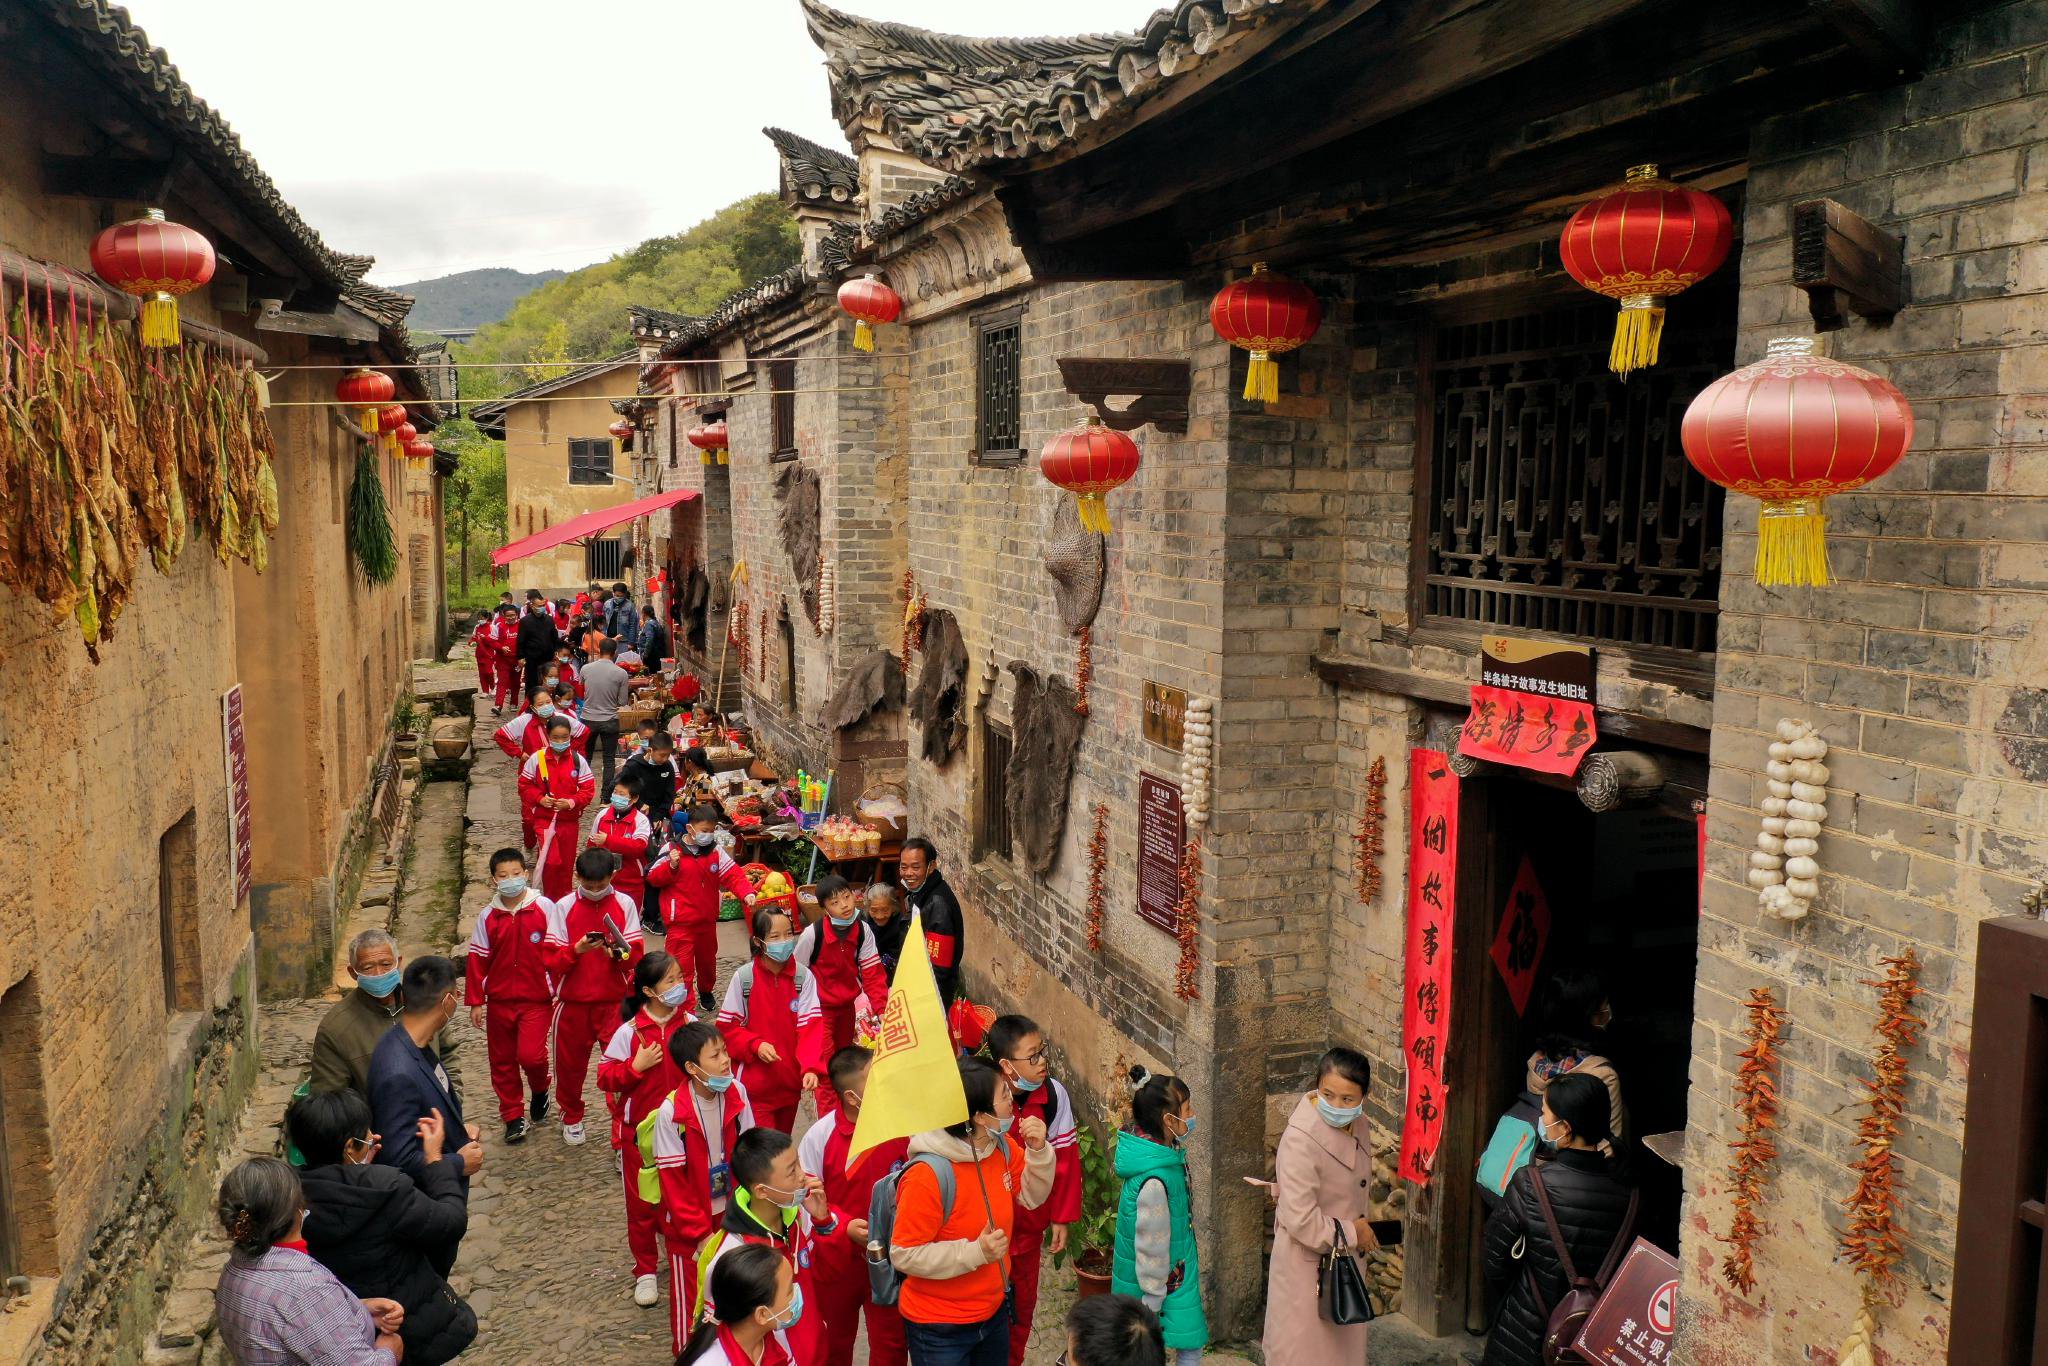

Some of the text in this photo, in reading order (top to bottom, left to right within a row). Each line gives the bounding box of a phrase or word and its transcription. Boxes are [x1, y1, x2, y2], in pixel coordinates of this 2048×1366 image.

[1483, 671, 1588, 700] 半条被子故事发生地旧址
[1616, 1336, 1624, 1346] No
[1625, 1343, 1647, 1364] Smoking
